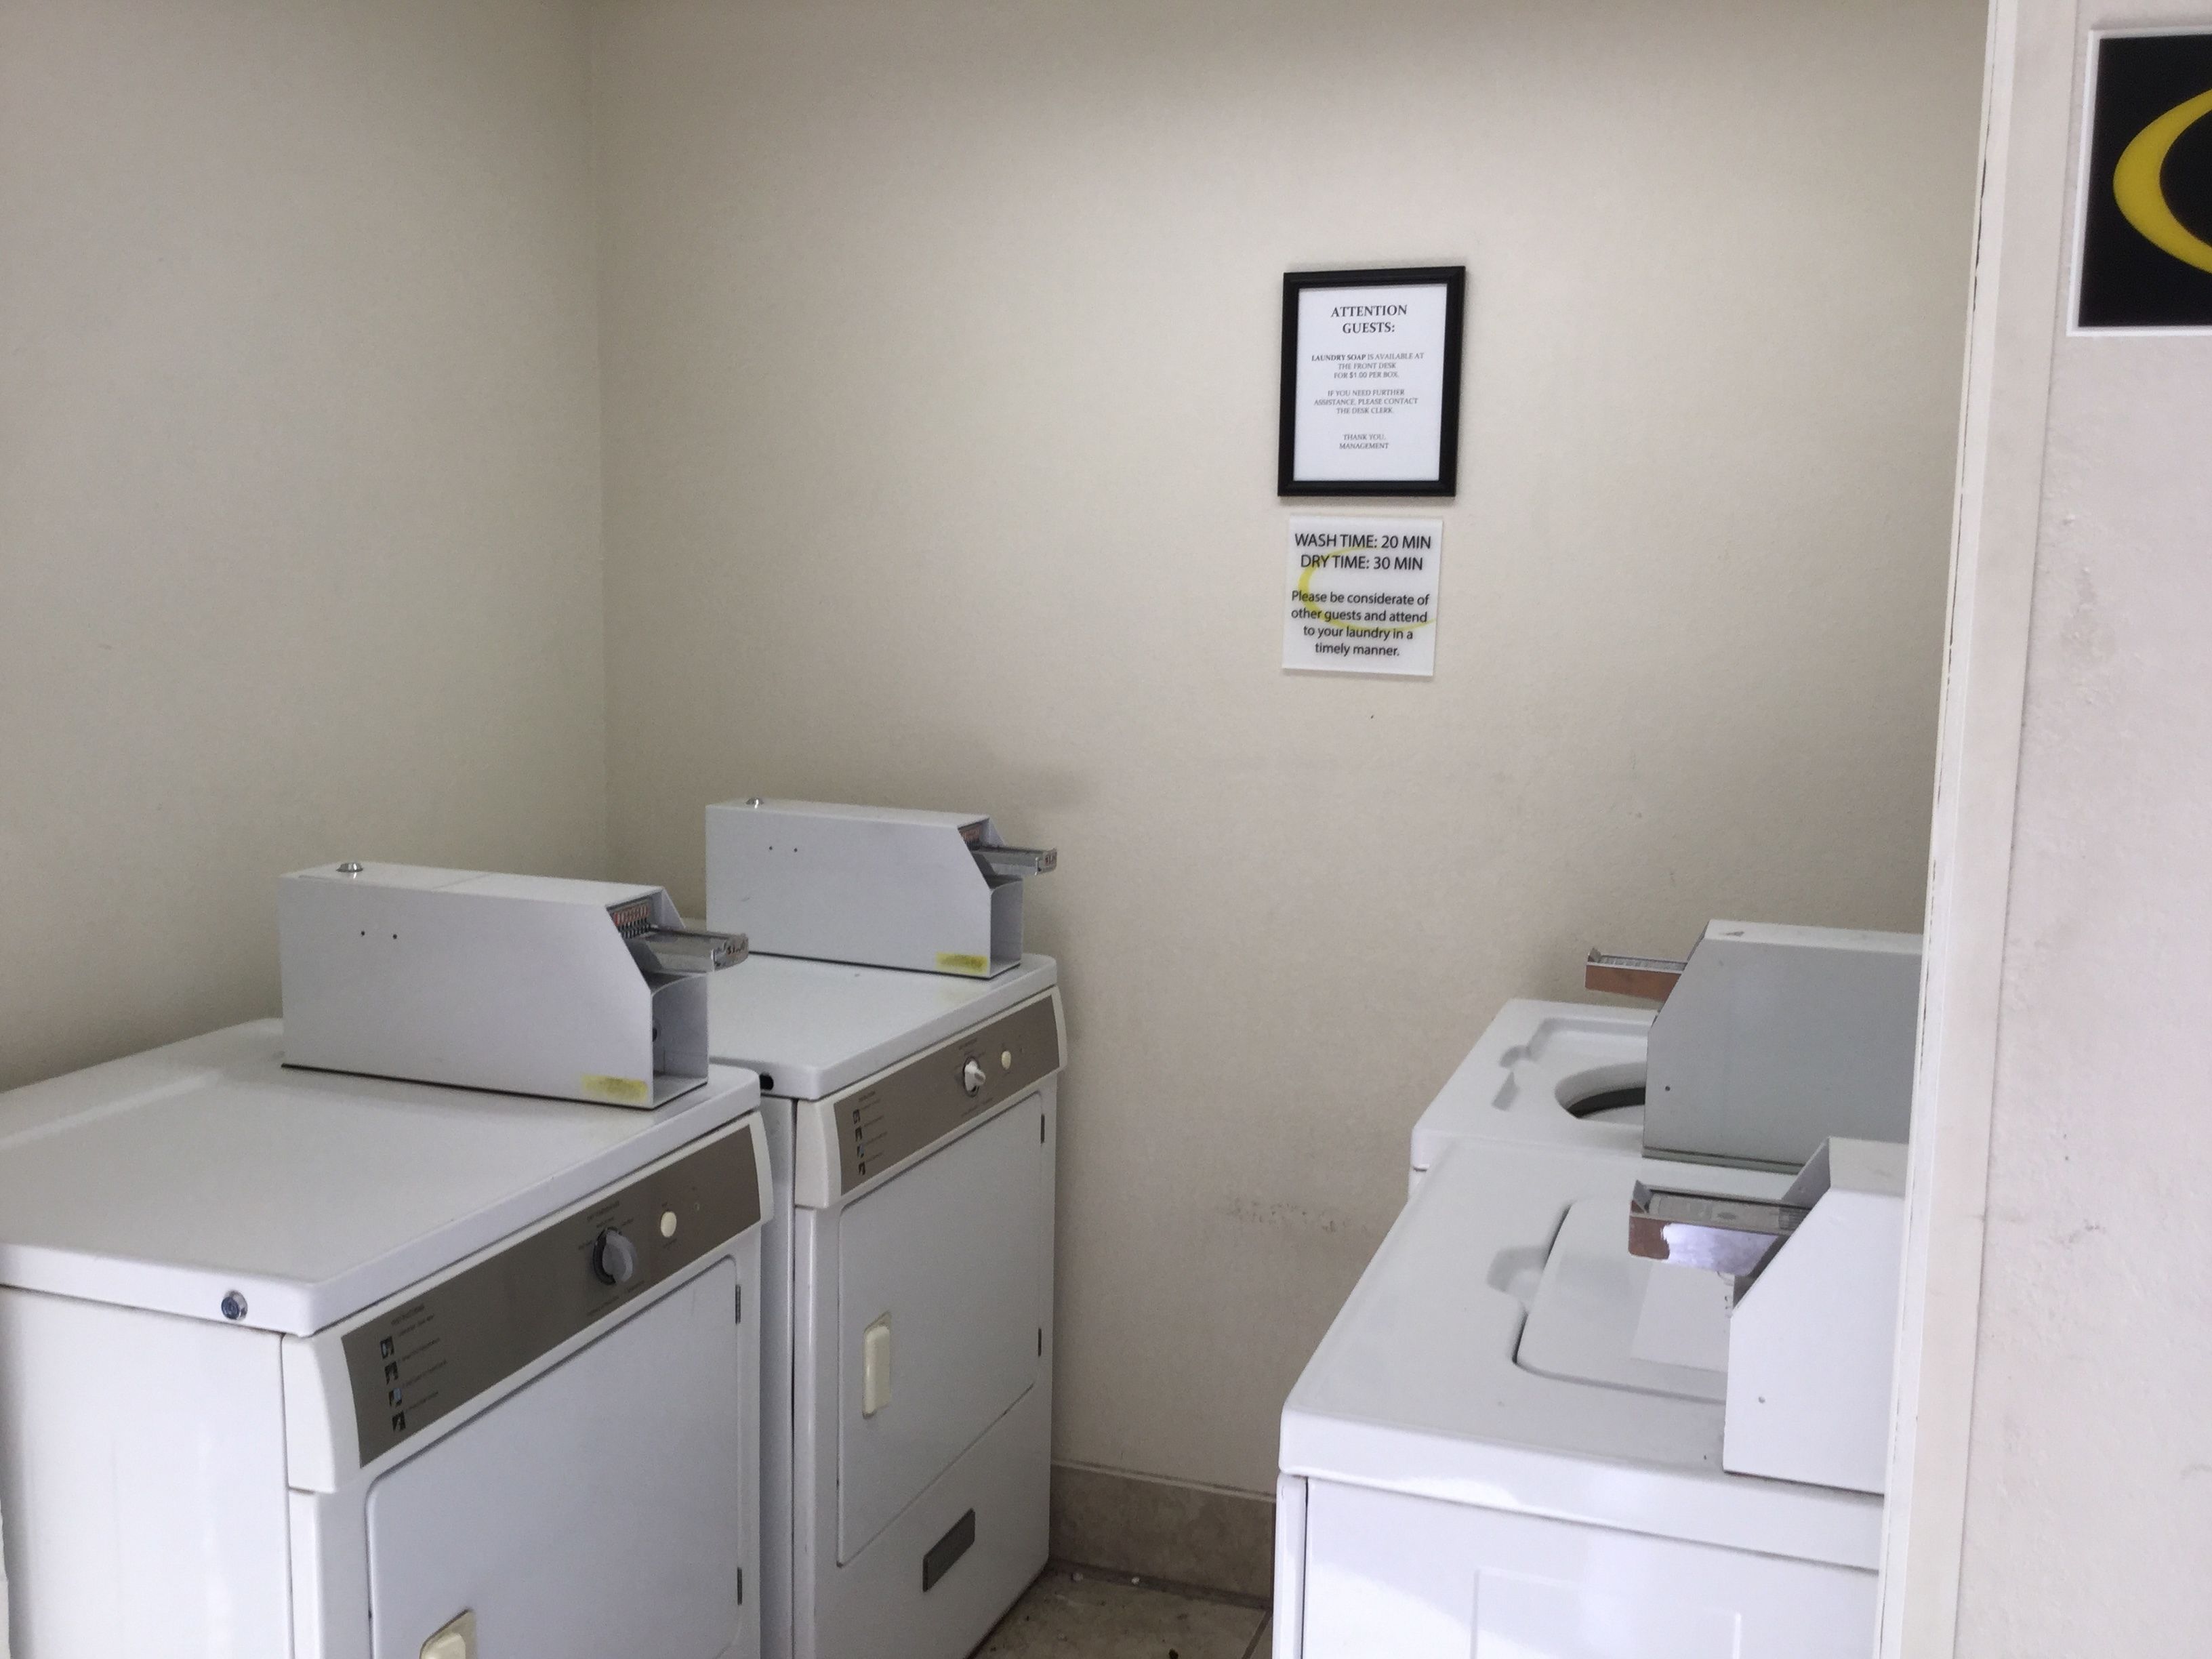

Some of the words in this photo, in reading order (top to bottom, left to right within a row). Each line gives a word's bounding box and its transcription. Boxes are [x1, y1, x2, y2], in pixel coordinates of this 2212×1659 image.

[1331, 304, 1408, 317] ATTENTION
[1343, 322, 1395, 333] GUESTS:
[1294, 533, 1336, 548] WASH
[1340, 534, 1377, 548] TIME:
[1381, 535, 1398, 549] 20
[1402, 535, 1431, 550] MIN
[1300, 554, 1330, 568] DRY
[1332, 555, 1370, 569] TIME:
[1374, 557, 1390, 569] 30
[1394, 557, 1423, 571] MIN
[1292, 590, 1327, 602] Please
[1330, 591, 1345, 603] be
[1347, 592, 1414, 605] considerate
[1417, 594, 1430, 606] of
[1291, 609, 1322, 619] other
[1324, 610, 1361, 622] guests
[1364, 611, 1386, 621] and
[1389, 611, 1427, 623] attend
[1303, 626, 1315, 636] to
[1318, 628, 1343, 638] your
[1346, 627, 1390, 641] laundry
[1393, 628, 1404, 639] in
[1406, 632, 1413, 640] a
[1315, 643, 1351, 657] timely
[1353, 646, 1399, 656] manner.
